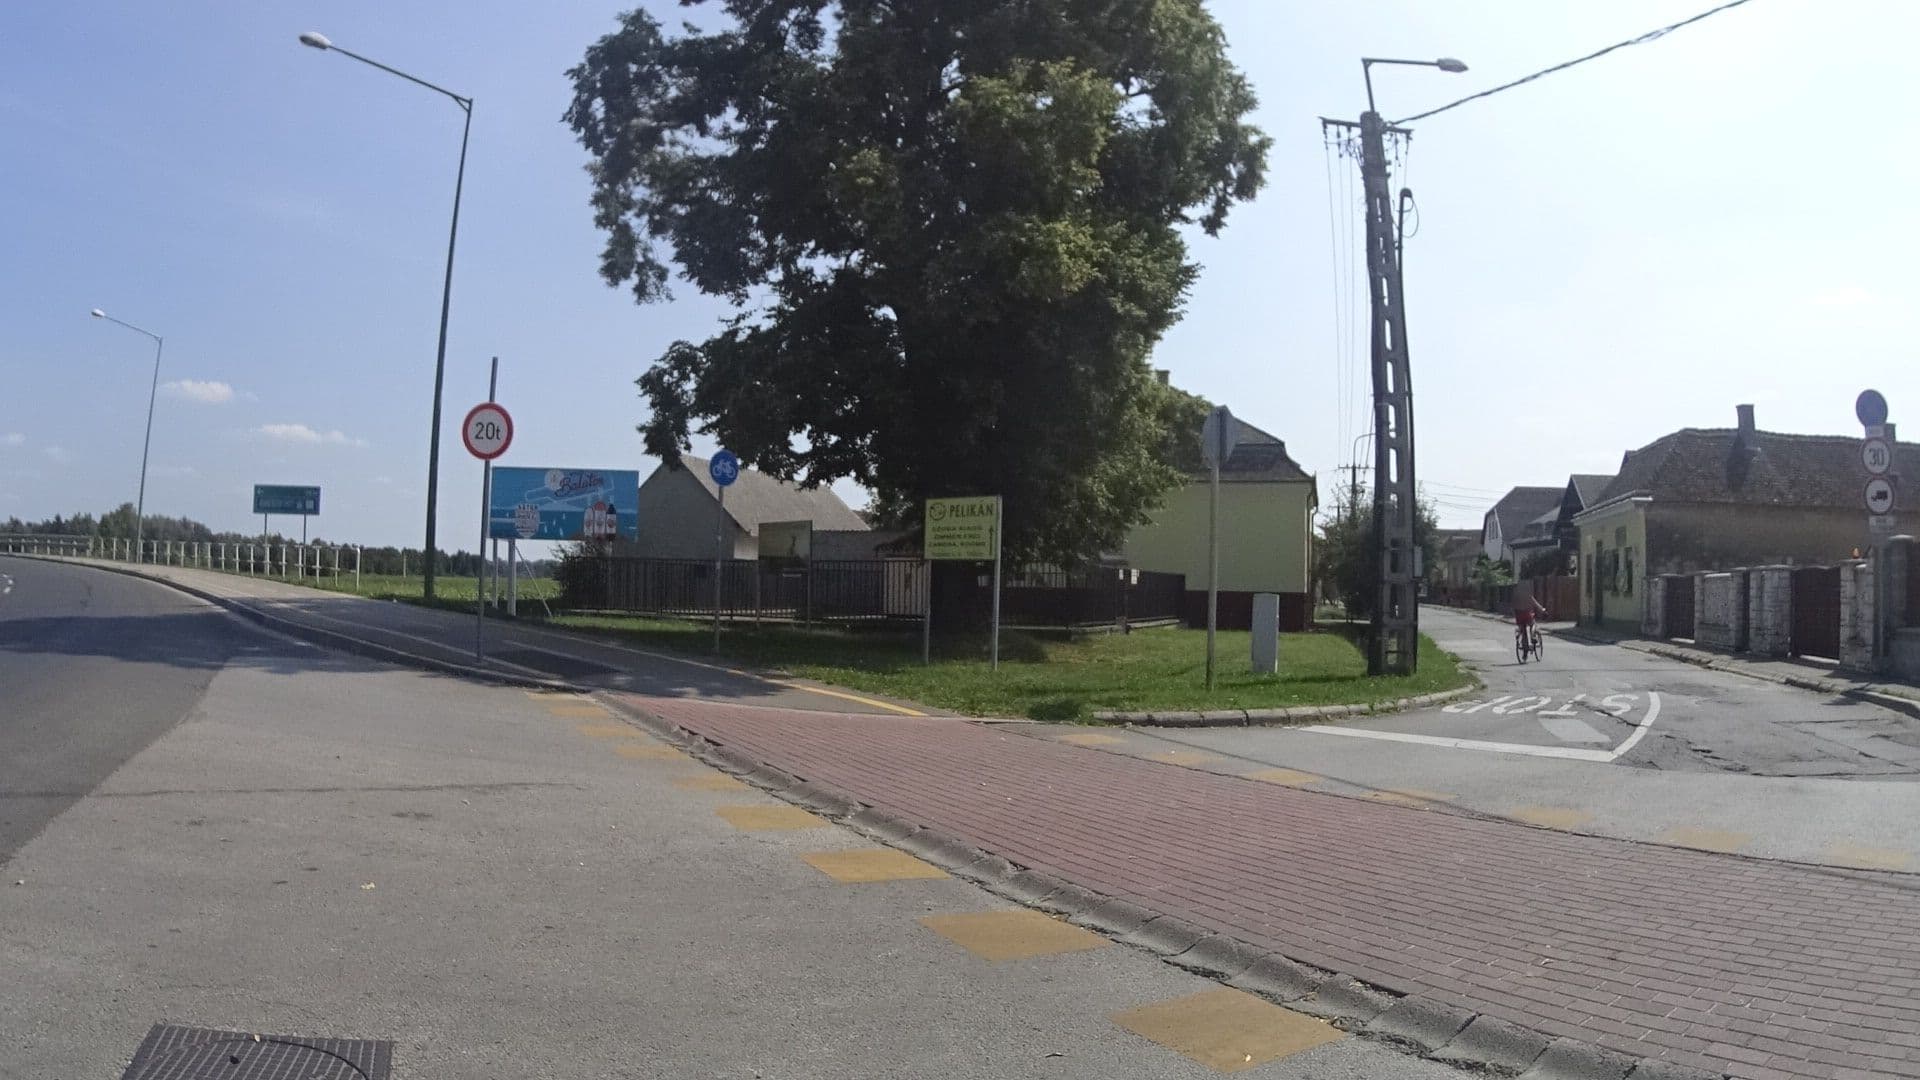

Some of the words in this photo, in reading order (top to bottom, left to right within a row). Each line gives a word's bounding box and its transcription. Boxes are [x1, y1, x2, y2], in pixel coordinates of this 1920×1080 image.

[475, 422, 501, 440] 20t
[1868, 448, 1884, 466] 30
[1442, 693, 1639, 716] STOP
